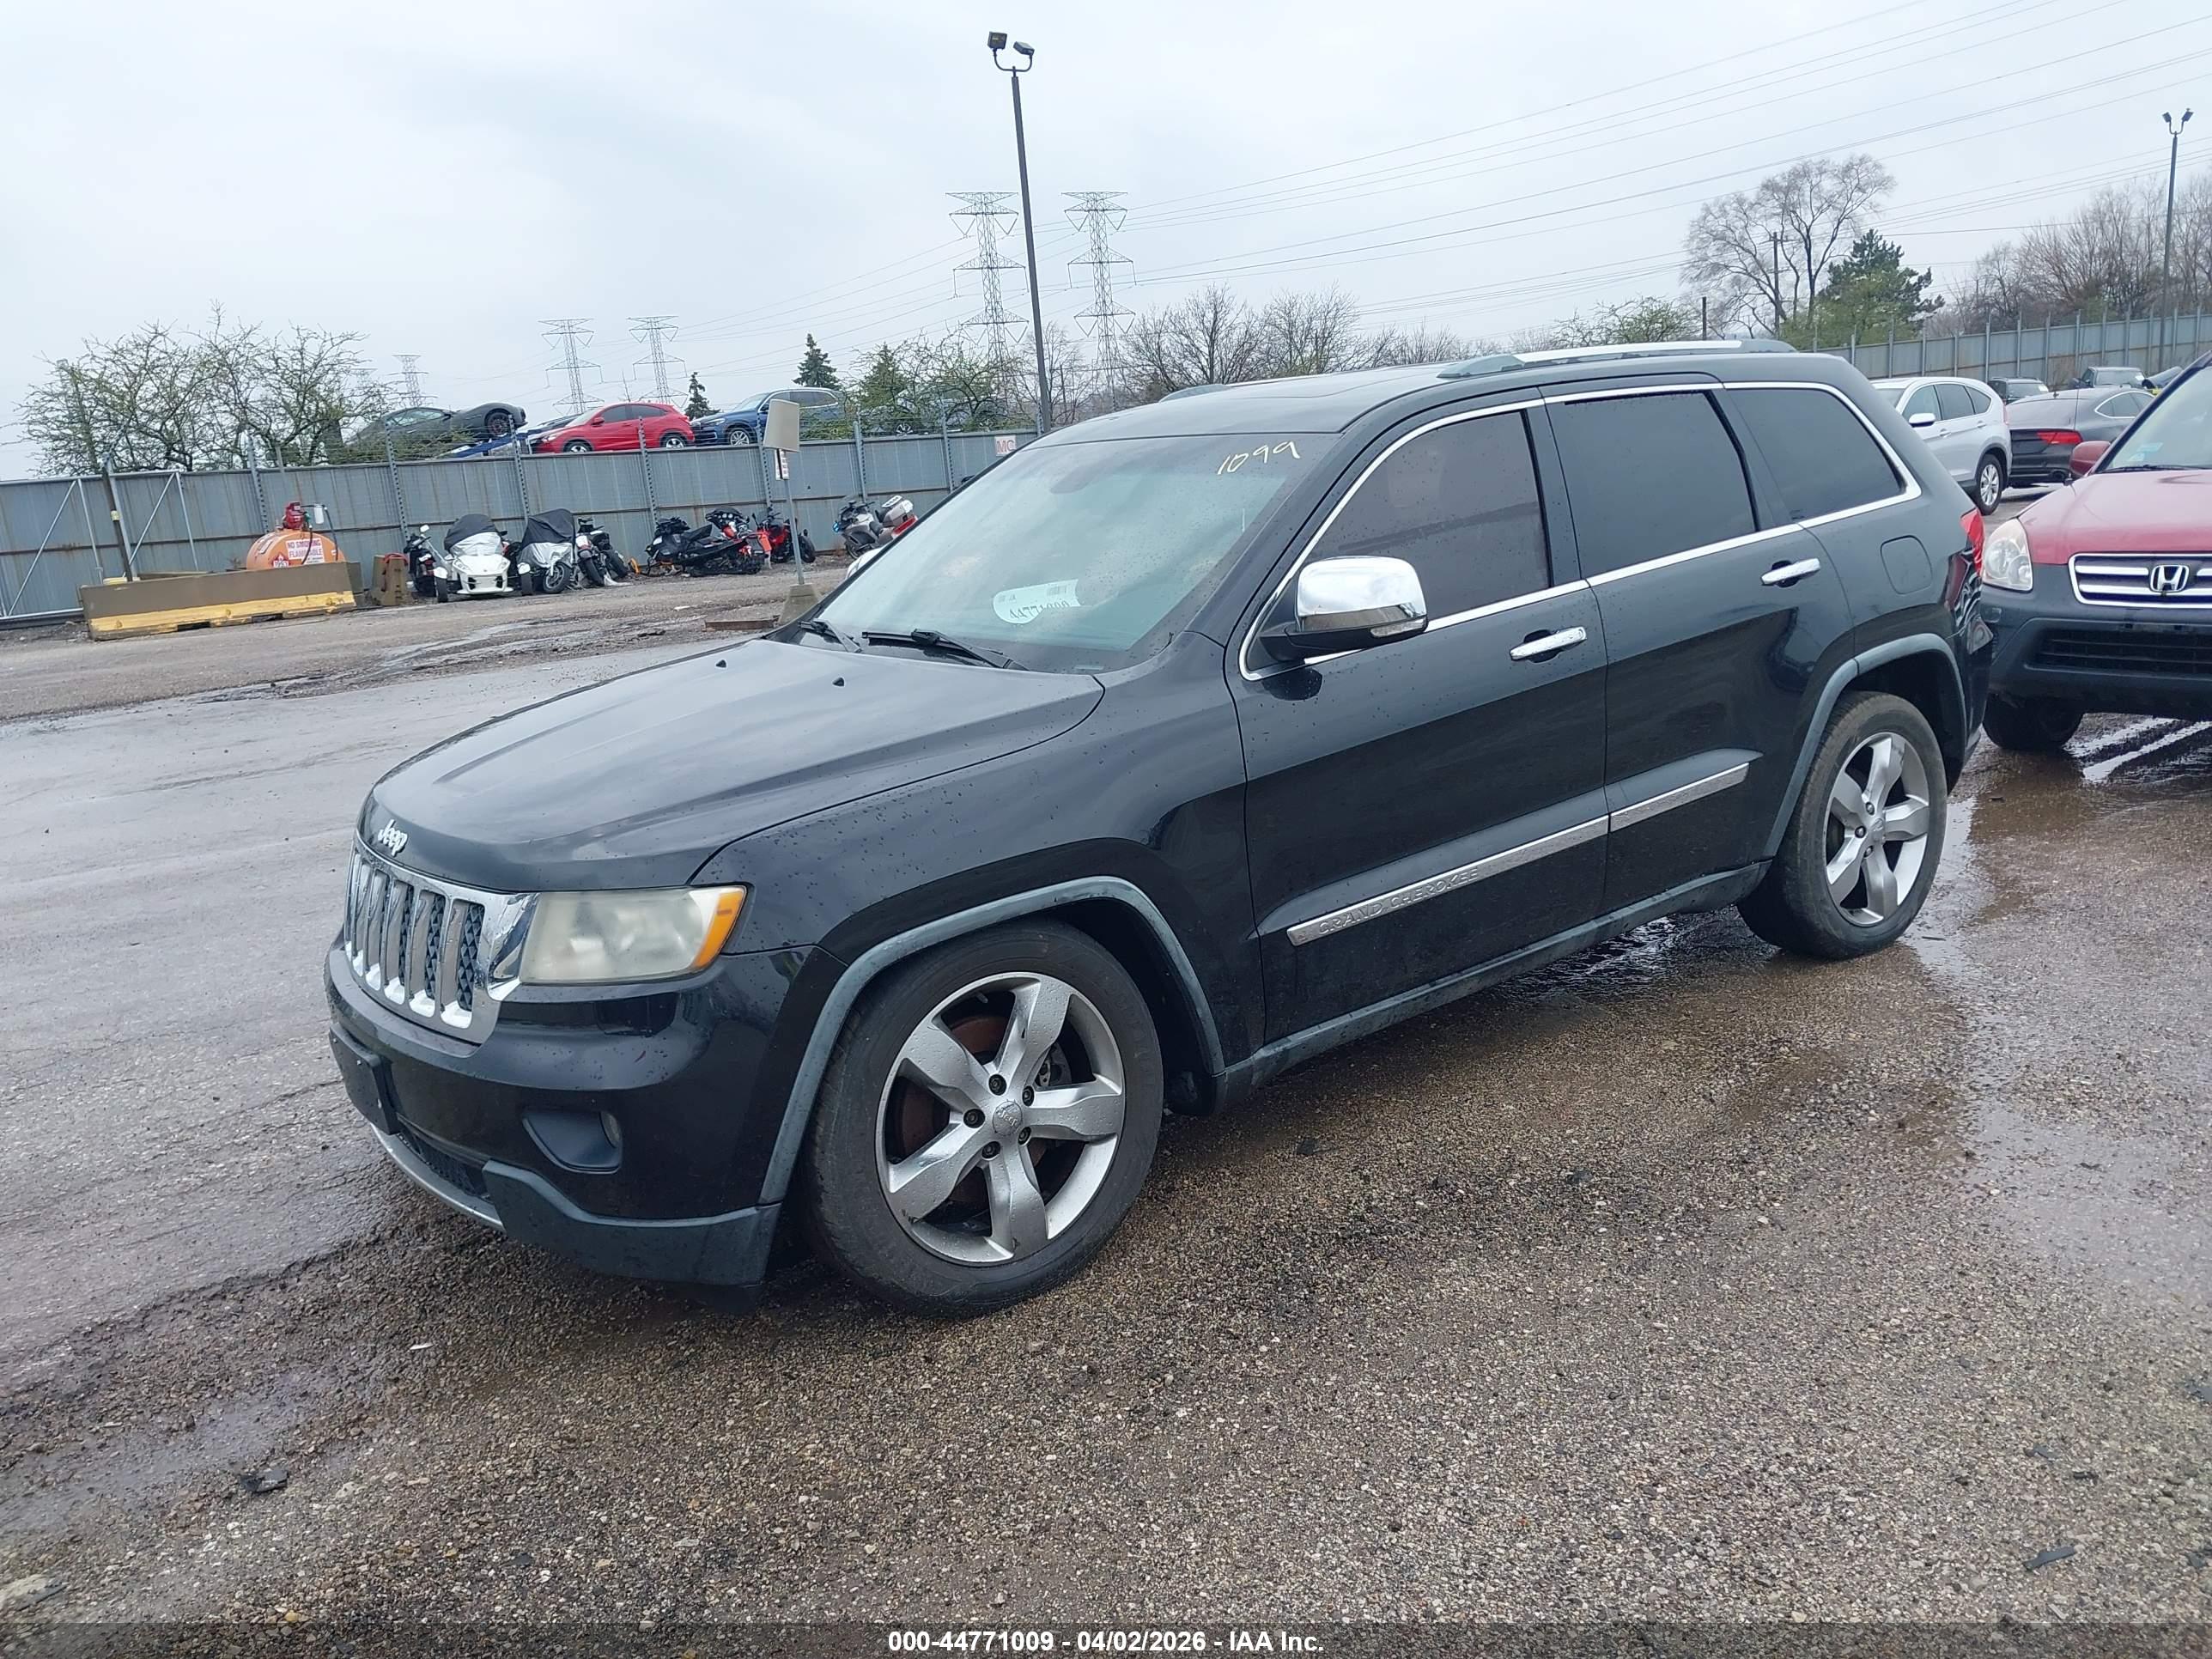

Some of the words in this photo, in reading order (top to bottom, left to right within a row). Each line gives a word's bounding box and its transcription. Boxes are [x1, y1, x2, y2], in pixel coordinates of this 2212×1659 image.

[996, 440, 1015, 453] MC
[1217, 441, 1301, 475] 1099
[378, 818, 409, 857] Jeep
[1318, 902, 1382, 935] GRAND
[1389, 866, 1479, 910] CHEROKEE
